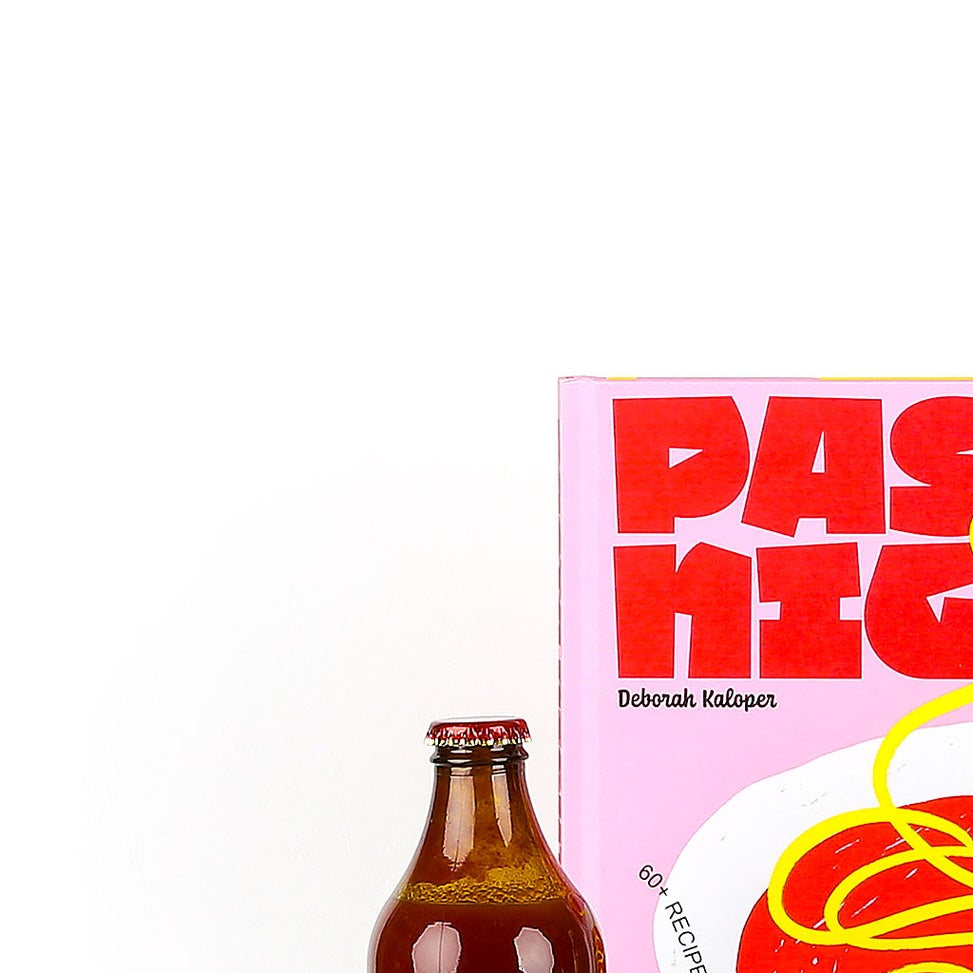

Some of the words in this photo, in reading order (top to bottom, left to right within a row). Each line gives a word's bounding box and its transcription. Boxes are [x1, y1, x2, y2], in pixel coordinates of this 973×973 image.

[618, 688, 696, 708] Deborah
[702, 688, 777, 712] Kaloper
[638, 864, 669, 896] 60+
